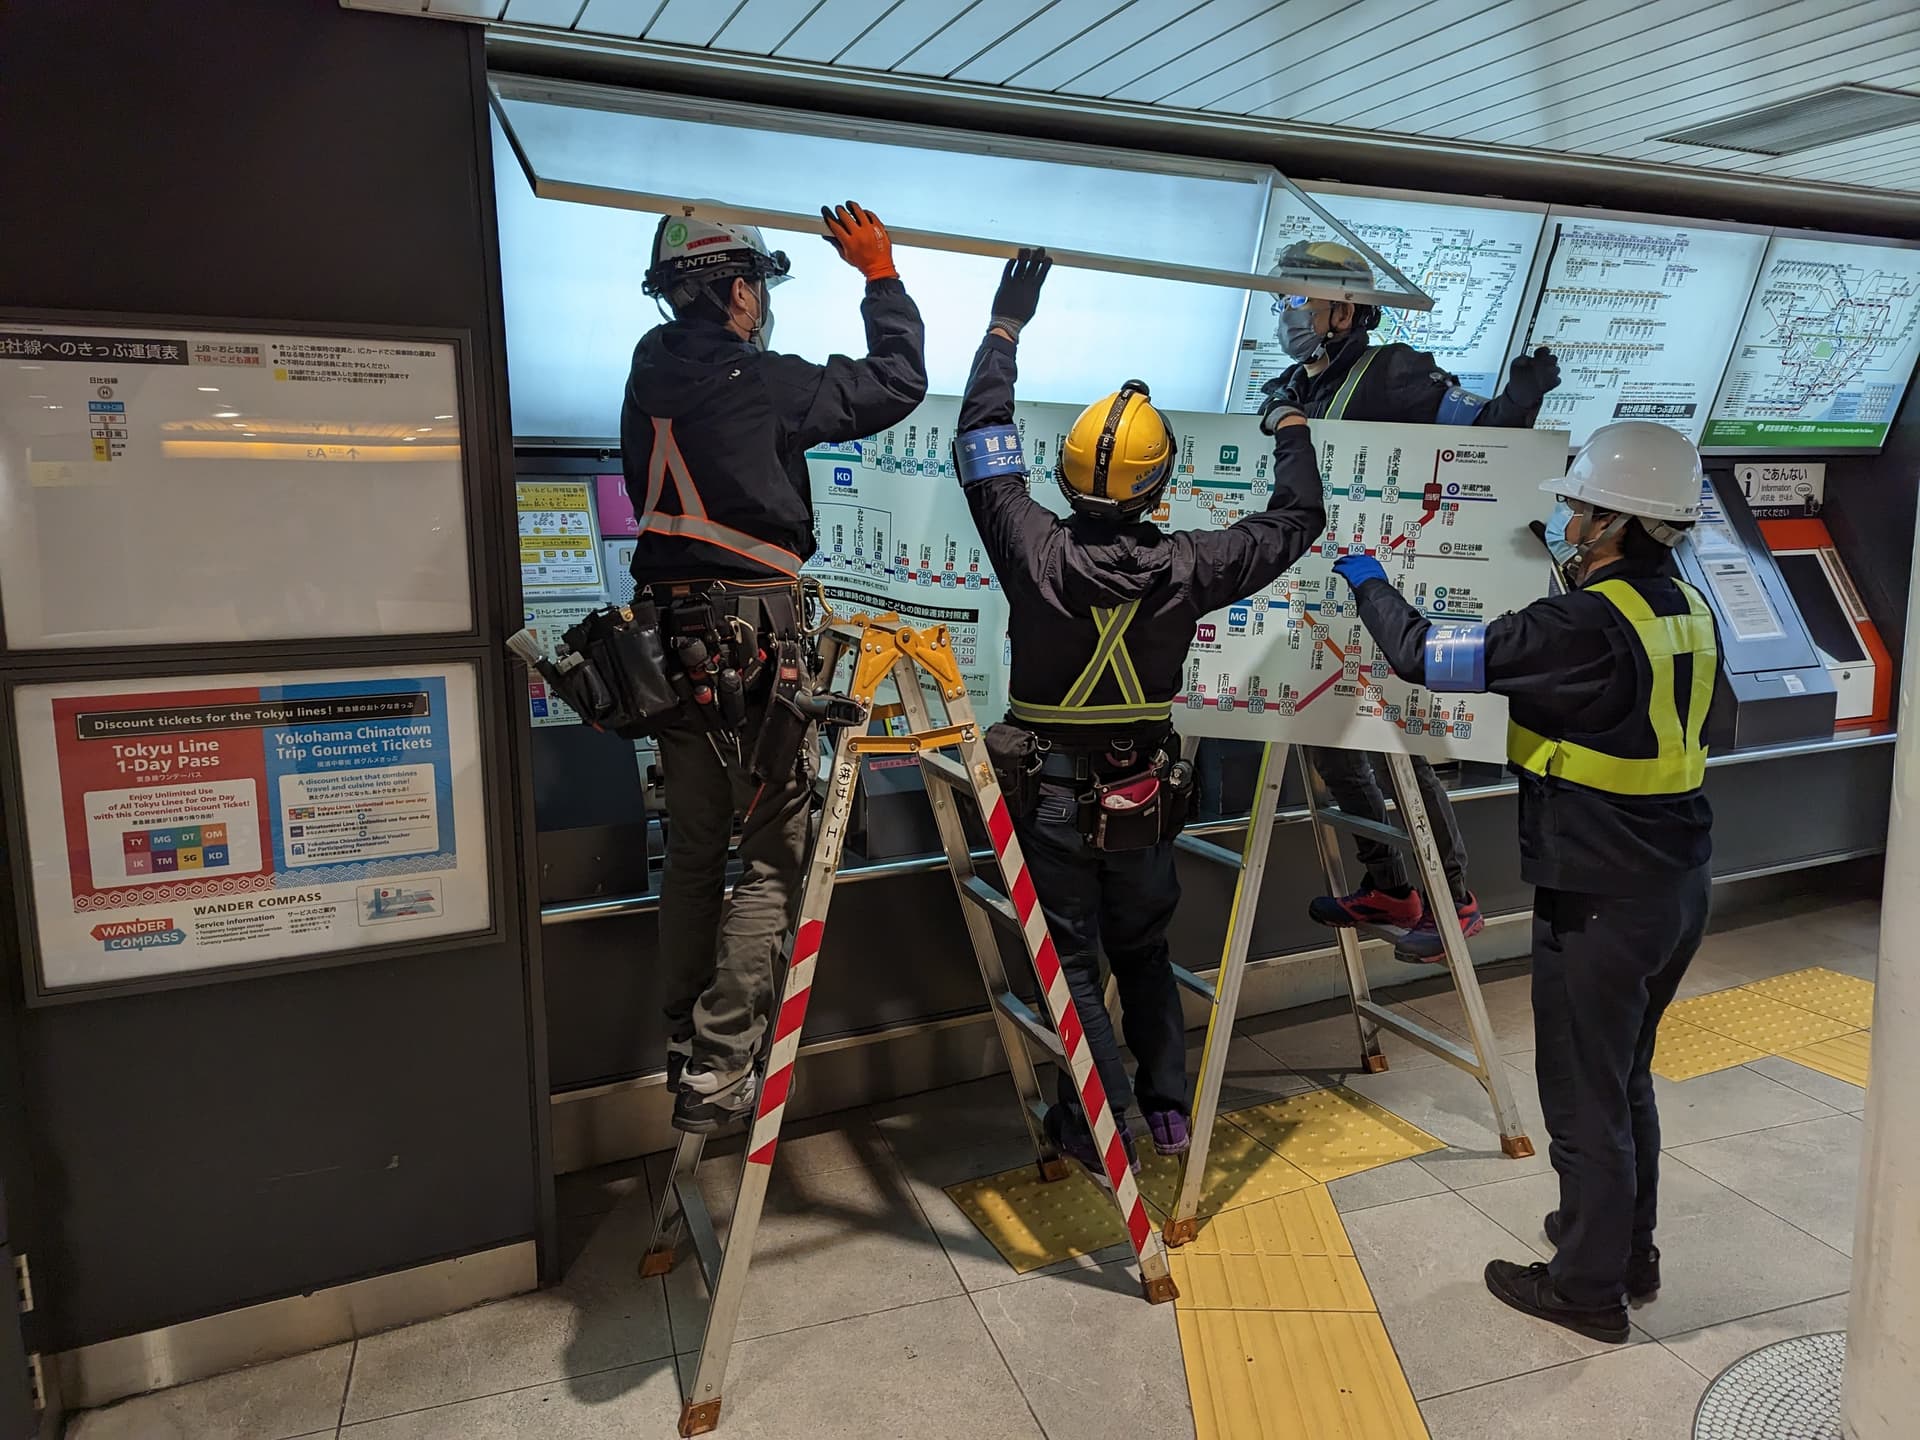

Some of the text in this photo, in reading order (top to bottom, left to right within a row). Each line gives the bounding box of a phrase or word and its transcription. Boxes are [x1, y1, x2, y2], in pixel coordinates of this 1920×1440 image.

[862, 448, 876, 456] 310
[1222, 451, 1236, 459] DT
[881, 456, 896, 466] 280
[902, 458, 917, 468] 280
[924, 461, 939, 470] 280
[836, 472, 850, 481] KD
[1762, 468, 1808, 480] ごあんない
[1351, 486, 1365, 494] 160
[1383, 488, 1398, 496] 130
[1406, 523, 1420, 532] 130
[1323, 543, 1338, 552] 160
[1350, 545, 1364, 553] 160
[1377, 547, 1392, 555] 130
[852, 558, 865, 566] 470
[895, 567, 908, 575] 280
[917, 571, 931, 580] 280
[941, 573, 956, 582] 280
[966, 574, 981, 583] 280
[1274, 580, 1288, 588] 200
[1253, 597, 1268, 605] 200
[1322, 601, 1336, 609] 200
[1230, 612, 1246, 622] MG
[1200, 628, 1214, 638] TM
[1313, 625, 1327, 633] 200
[961, 657, 974, 665] 204
[1372, 663, 1388, 671] 220
[1367, 686, 1381, 694] 200
[1189, 693, 1202, 701] 220
[1219, 695, 1233, 703] 220
[1250, 697, 1264, 705] 220
[1280, 701, 1295, 709] 200
[1385, 706, 1399, 714] 220
[94, 706, 333, 731] Discount tickets for the Tokyu lines!
[1407, 719, 1422, 727] 220
[1431, 720, 1445, 728] 220
[1455, 723, 1470, 731] 220
[275, 724, 432, 745] Yokohama Chinatown
[112, 740, 220, 759] Tokyu Line
[276, 737, 432, 761] Trip Gourmet Tickets
[116, 754, 220, 774] 1-Day Pass
[298, 770, 418, 786] A discount ticket that combines
[306, 784, 329, 793] travel
[331, 783, 346, 791] and
[348, 781, 374, 790] cuisine
[376, 779, 391, 787] into
[129, 793, 153, 802] Enjoy
[155, 789, 197, 799] Unlimited
[120, 802, 132, 810] All
[134, 799, 160, 810] Tokyu
[162, 798, 183, 807] Lines
[185, 797, 198, 805] for
[200, 795, 217, 804] One
[219, 794, 235, 803] Day
[93, 800, 250, 821] with this Convenient Discount Ticket!
[182, 833, 195, 841] DT
[205, 830, 223, 839] OM
[129, 838, 143, 846] TY
[153, 836, 171, 845] MG
[183, 854, 197, 863] SG
[208, 851, 223, 860] KD
[133, 859, 144, 868] IK
[156, 857, 173, 866] TM
[193, 892, 322, 916] WANDER COMPASS
[101, 921, 166, 937] WANDER
[195, 921, 225, 930] Service
